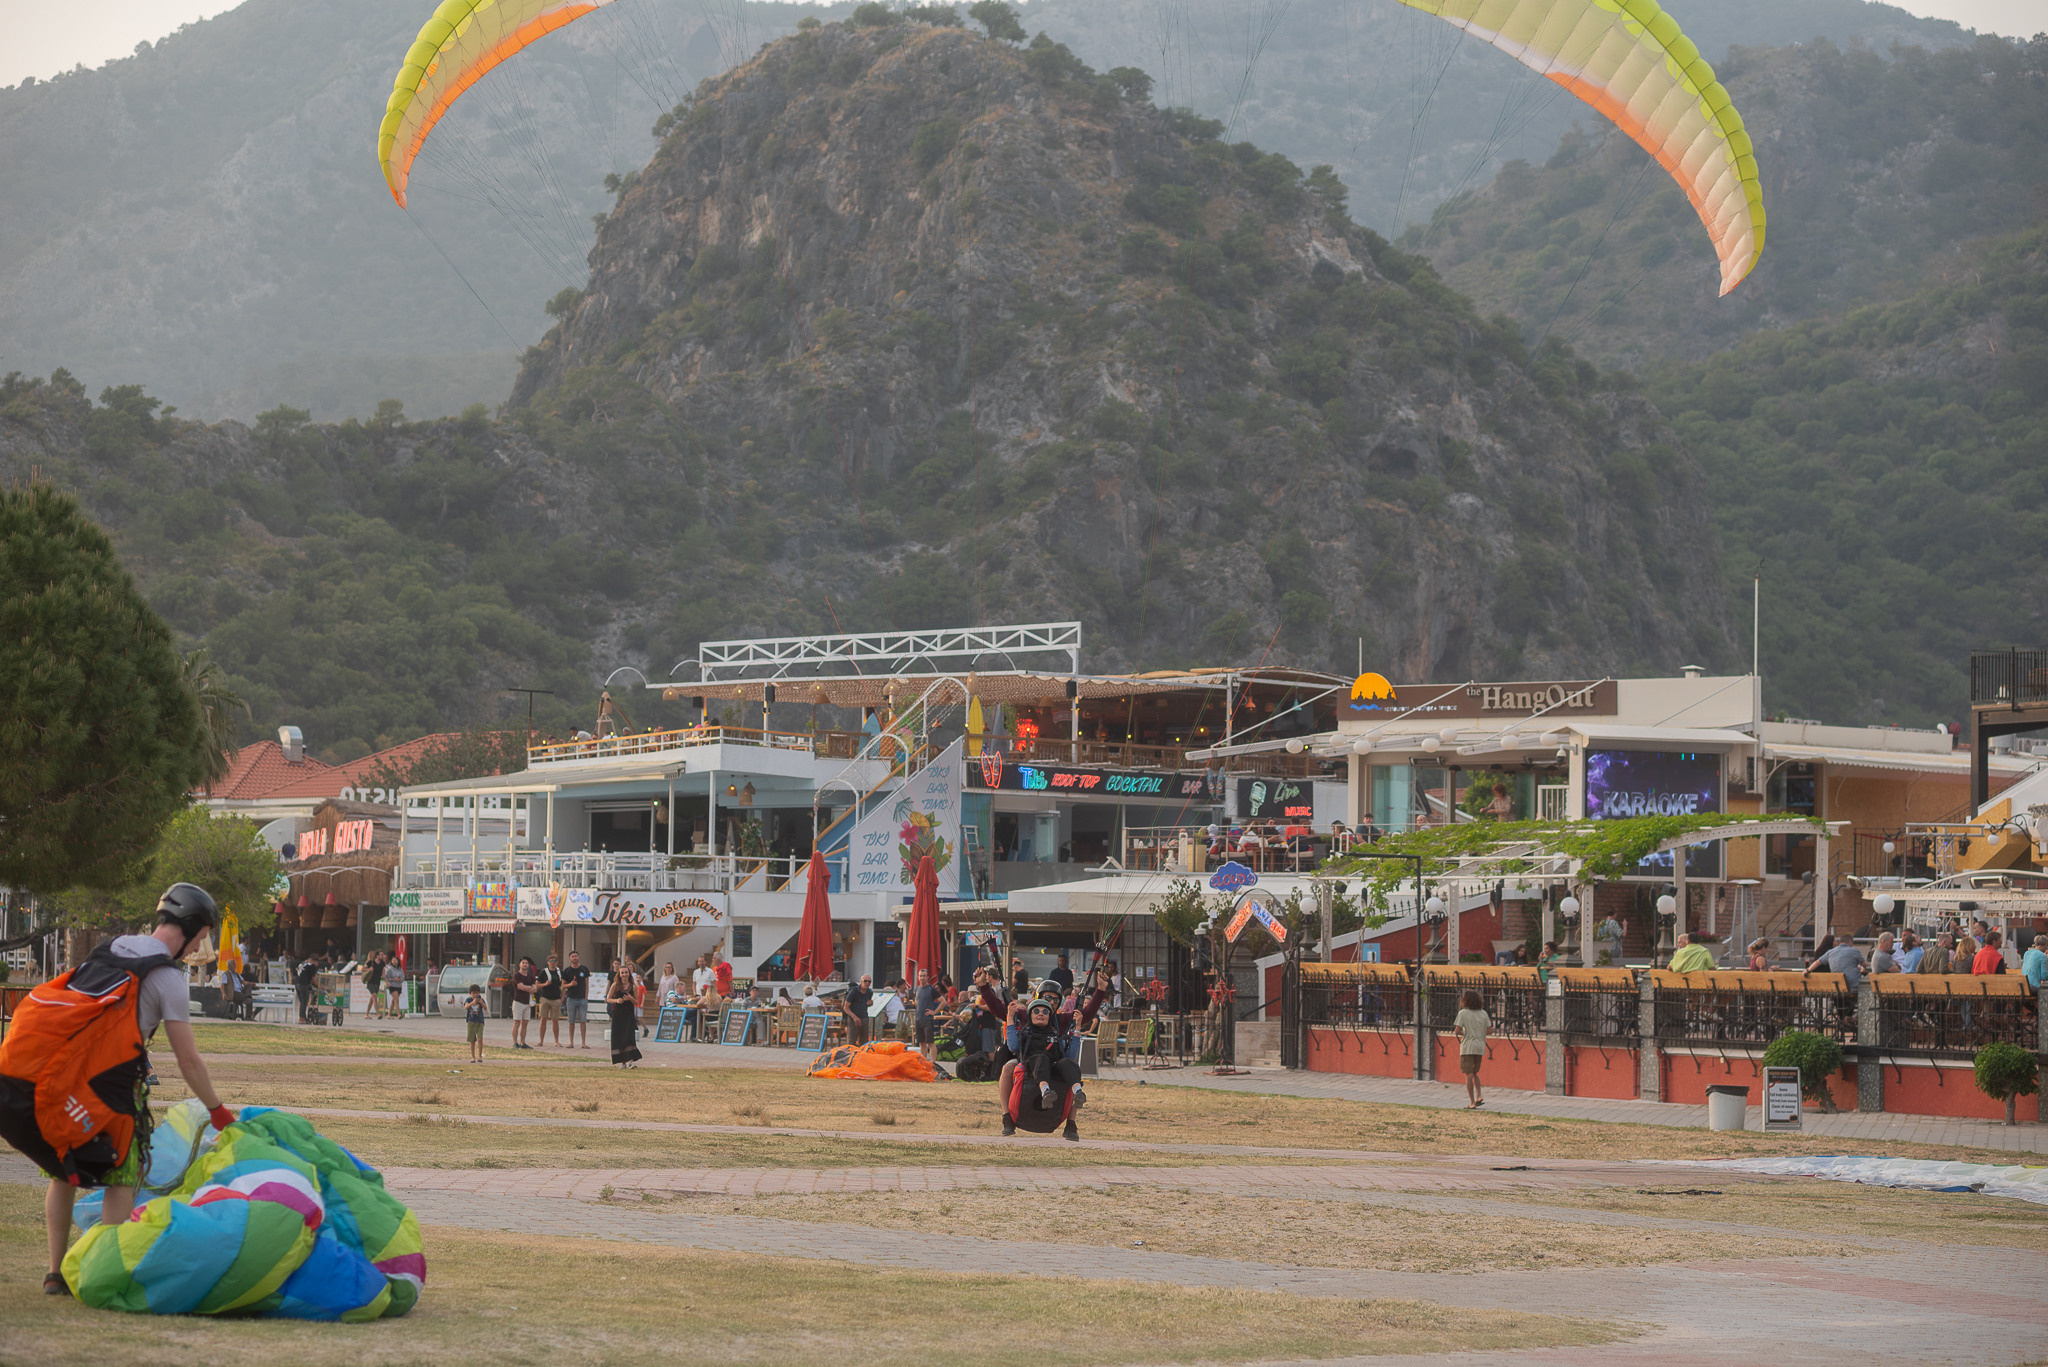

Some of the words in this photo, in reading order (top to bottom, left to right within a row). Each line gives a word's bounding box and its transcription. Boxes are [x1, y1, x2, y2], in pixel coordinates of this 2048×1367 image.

[1466, 686, 1480, 697] the
[1018, 766, 1048, 790] Tiki
[1105, 775, 1163, 793] COCKTAIL
[1181, 780, 1202, 794] BAR
[926, 782, 949, 794] BAR
[1273, 781, 1301, 804] Live
[1603, 790, 1698, 817] KARAOKE
[1285, 806, 1312, 817] MUSIC
[333, 819, 374, 855] GUSTO
[862, 852, 889, 866] BAR
[856, 871, 889, 885] TIME
[1211, 873, 1247, 887] CLOUD
[389, 892, 421, 908] FOCUS
[475, 897, 507, 911] WAFFLE
[592, 890, 646, 926] Tiki
[649, 897, 724, 923] Restaurant
[673, 911, 700, 926] Bar
